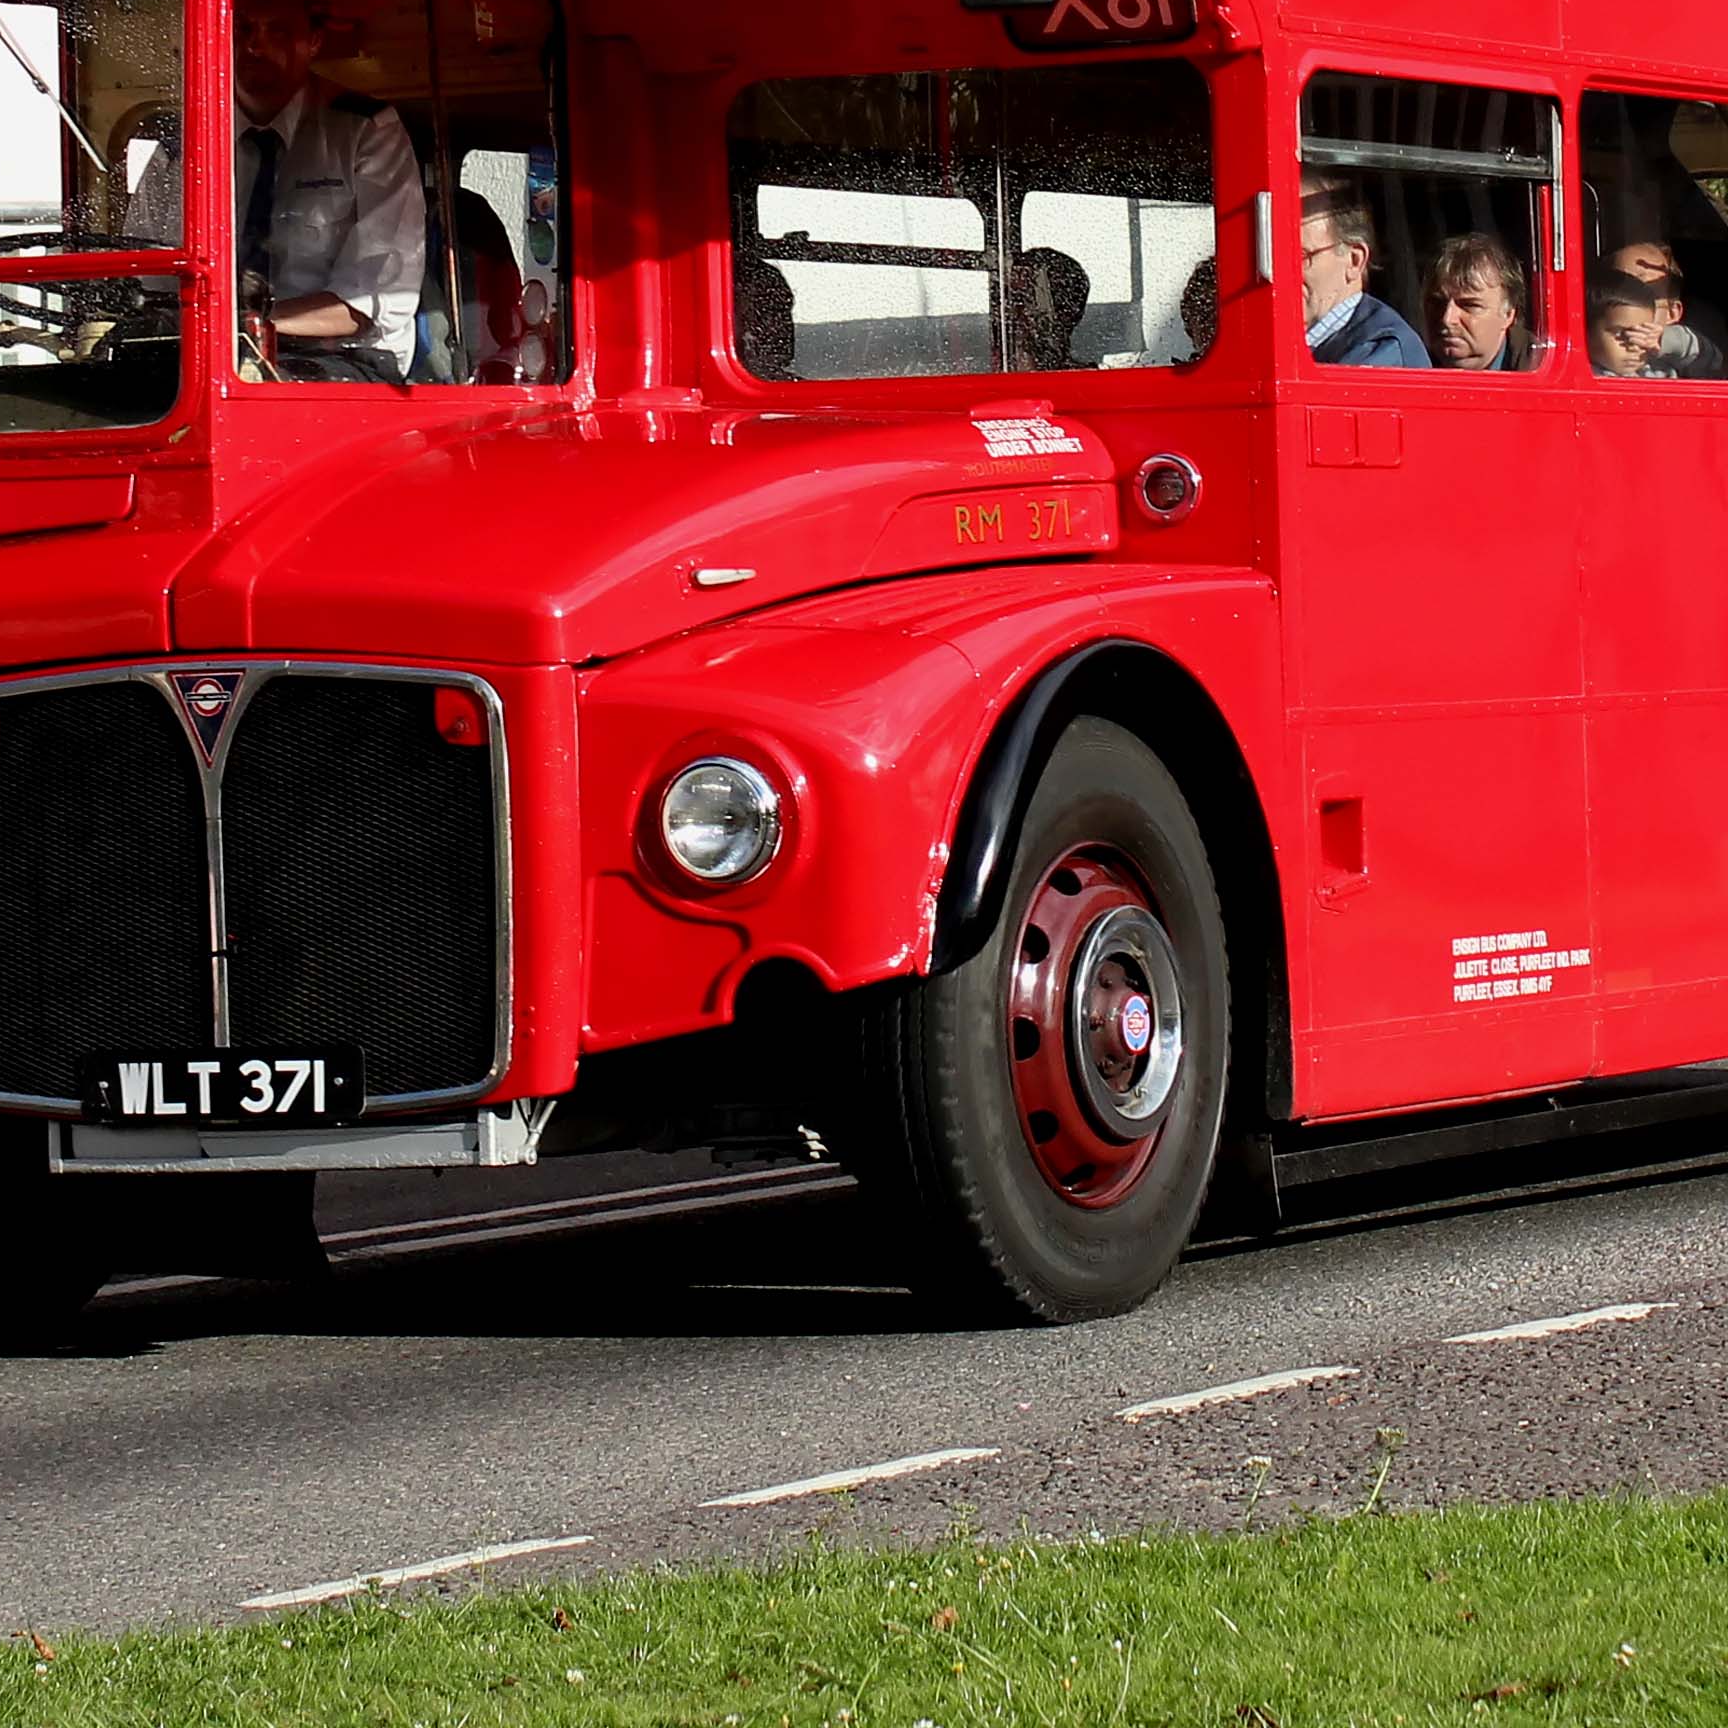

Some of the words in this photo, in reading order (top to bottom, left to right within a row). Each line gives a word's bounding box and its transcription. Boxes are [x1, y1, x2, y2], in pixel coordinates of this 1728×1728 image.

[982, 428, 1034, 442] ENGINE
[1030, 426, 1066, 439] STOP
[984, 442, 1034, 457] UNDER
[1032, 438, 1084, 453] BONNET
[954, 503, 1004, 544] RM
[1026, 498, 1072, 541] 371
[1481, 935, 1497, 953] BUS
[1497, 931, 1533, 951] COMPANY
[1453, 959, 1489, 979] JULIETTE
[1520, 952, 1556, 972] PURFLEET
[1570, 948, 1591, 966] PARK
[118, 1061, 221, 1115] WLT
[238, 1059, 326, 1114] 371
